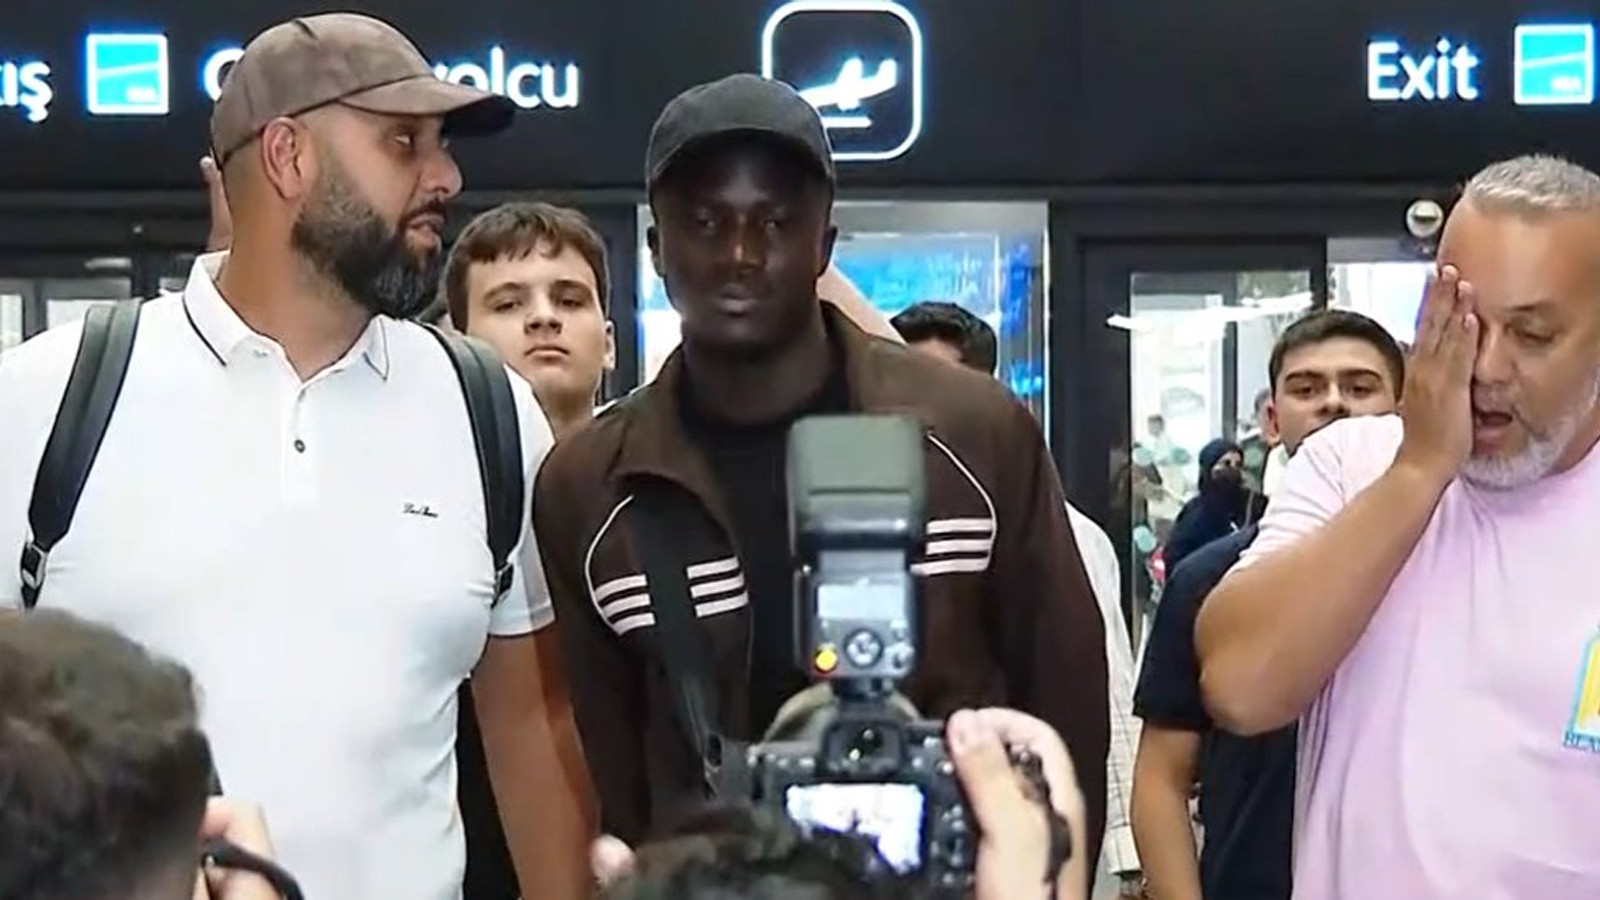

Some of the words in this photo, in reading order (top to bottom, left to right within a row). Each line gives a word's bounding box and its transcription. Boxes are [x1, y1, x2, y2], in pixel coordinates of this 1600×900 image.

[0, 61, 53, 122] ış
[434, 46, 578, 108] olcu
[1367, 38, 1479, 100] Exit
